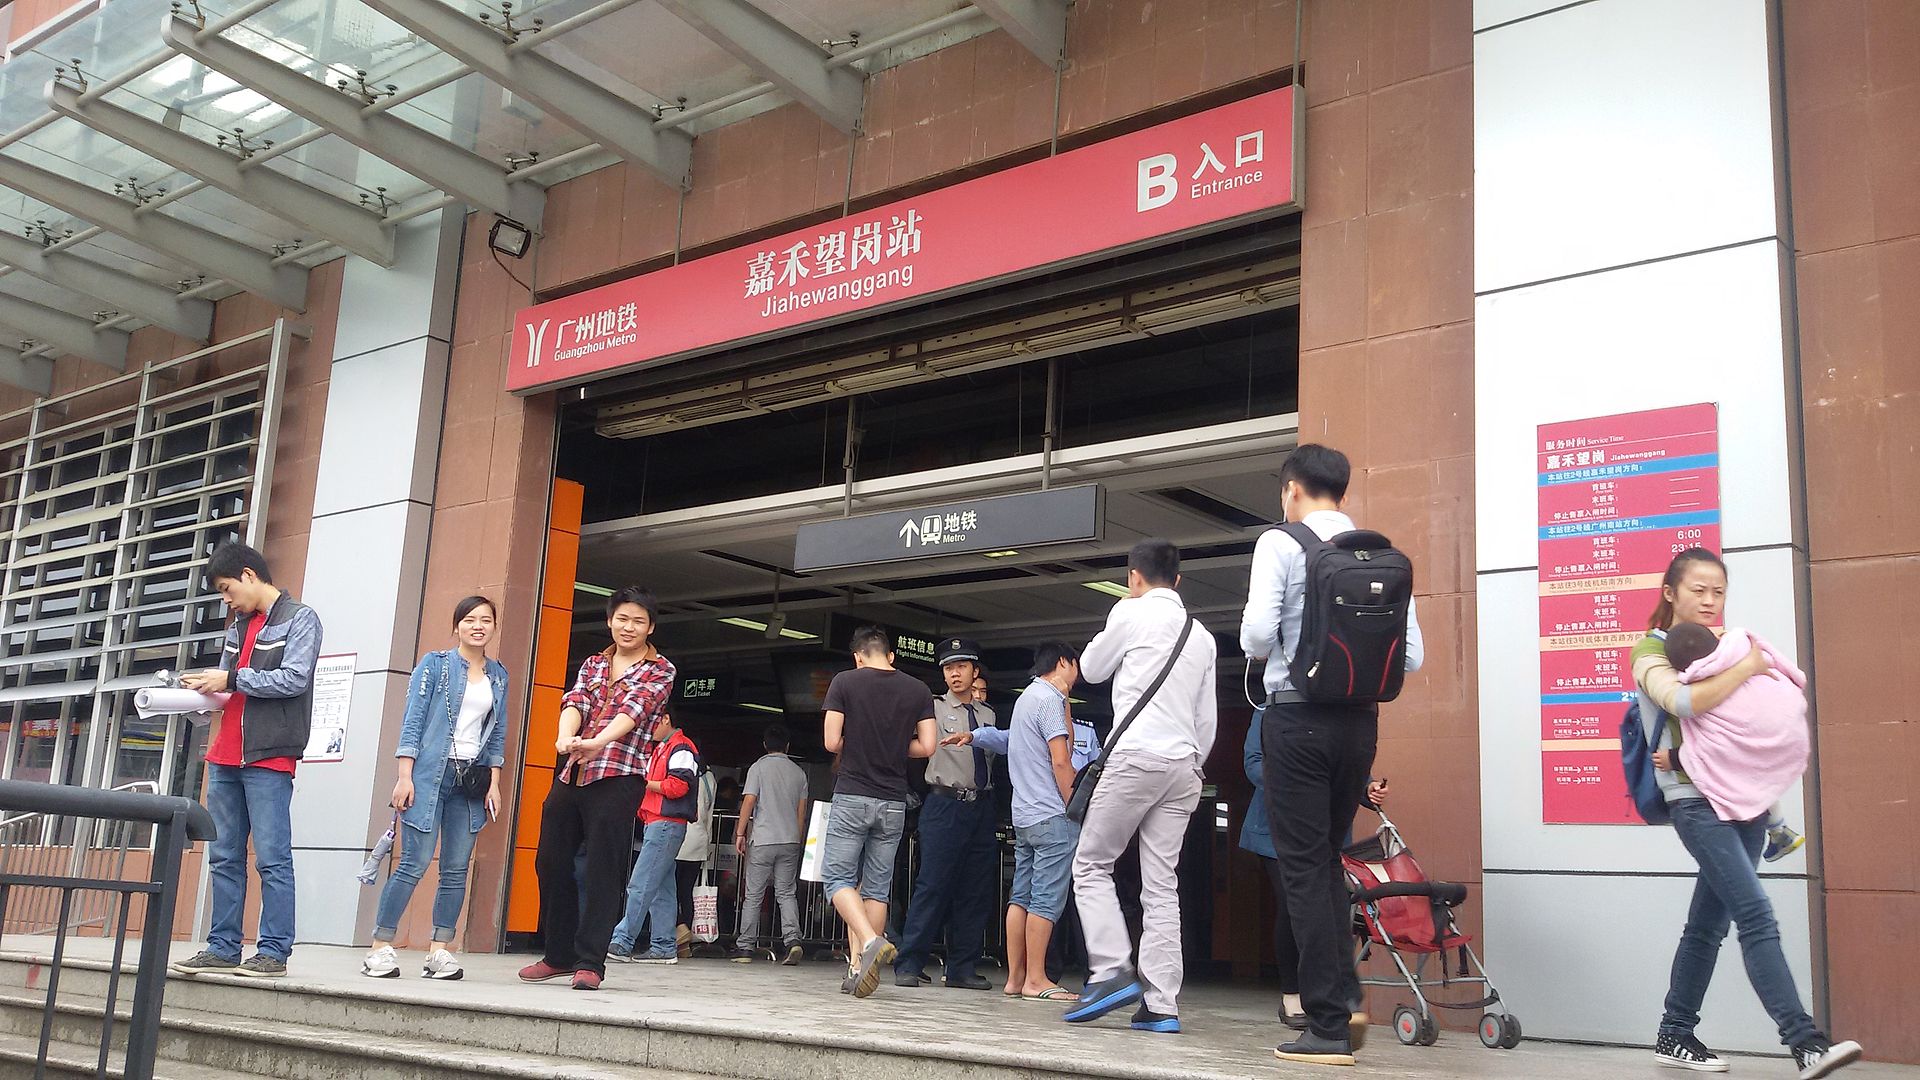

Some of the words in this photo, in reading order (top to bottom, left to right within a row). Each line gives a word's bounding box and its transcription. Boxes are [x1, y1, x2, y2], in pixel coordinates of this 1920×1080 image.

[1192, 129, 1264, 180] 入口
[1137, 153, 1179, 213] B
[1191, 170, 1263, 199] Entrance
[744, 209, 923, 299] 嘉禾望岗站
[761, 265, 913, 318] Jiahewanggang
[556, 302, 638, 349] 广州地铁
[554, 340, 605, 362] Guangzhou
[606, 333, 637, 349] Metro
[1546, 437, 1586, 450] 服务时间
[1547, 450, 1605, 470] 嘉禾望岗
[1611, 450, 1666, 461] Jiahewanggang
[943, 510, 977, 532] 地铁
[942, 534, 966, 544] Metro
[1677, 529, 1701, 540] 6:00
[897, 635, 935, 655] 航班信息
[698, 678, 716, 691] 车票
